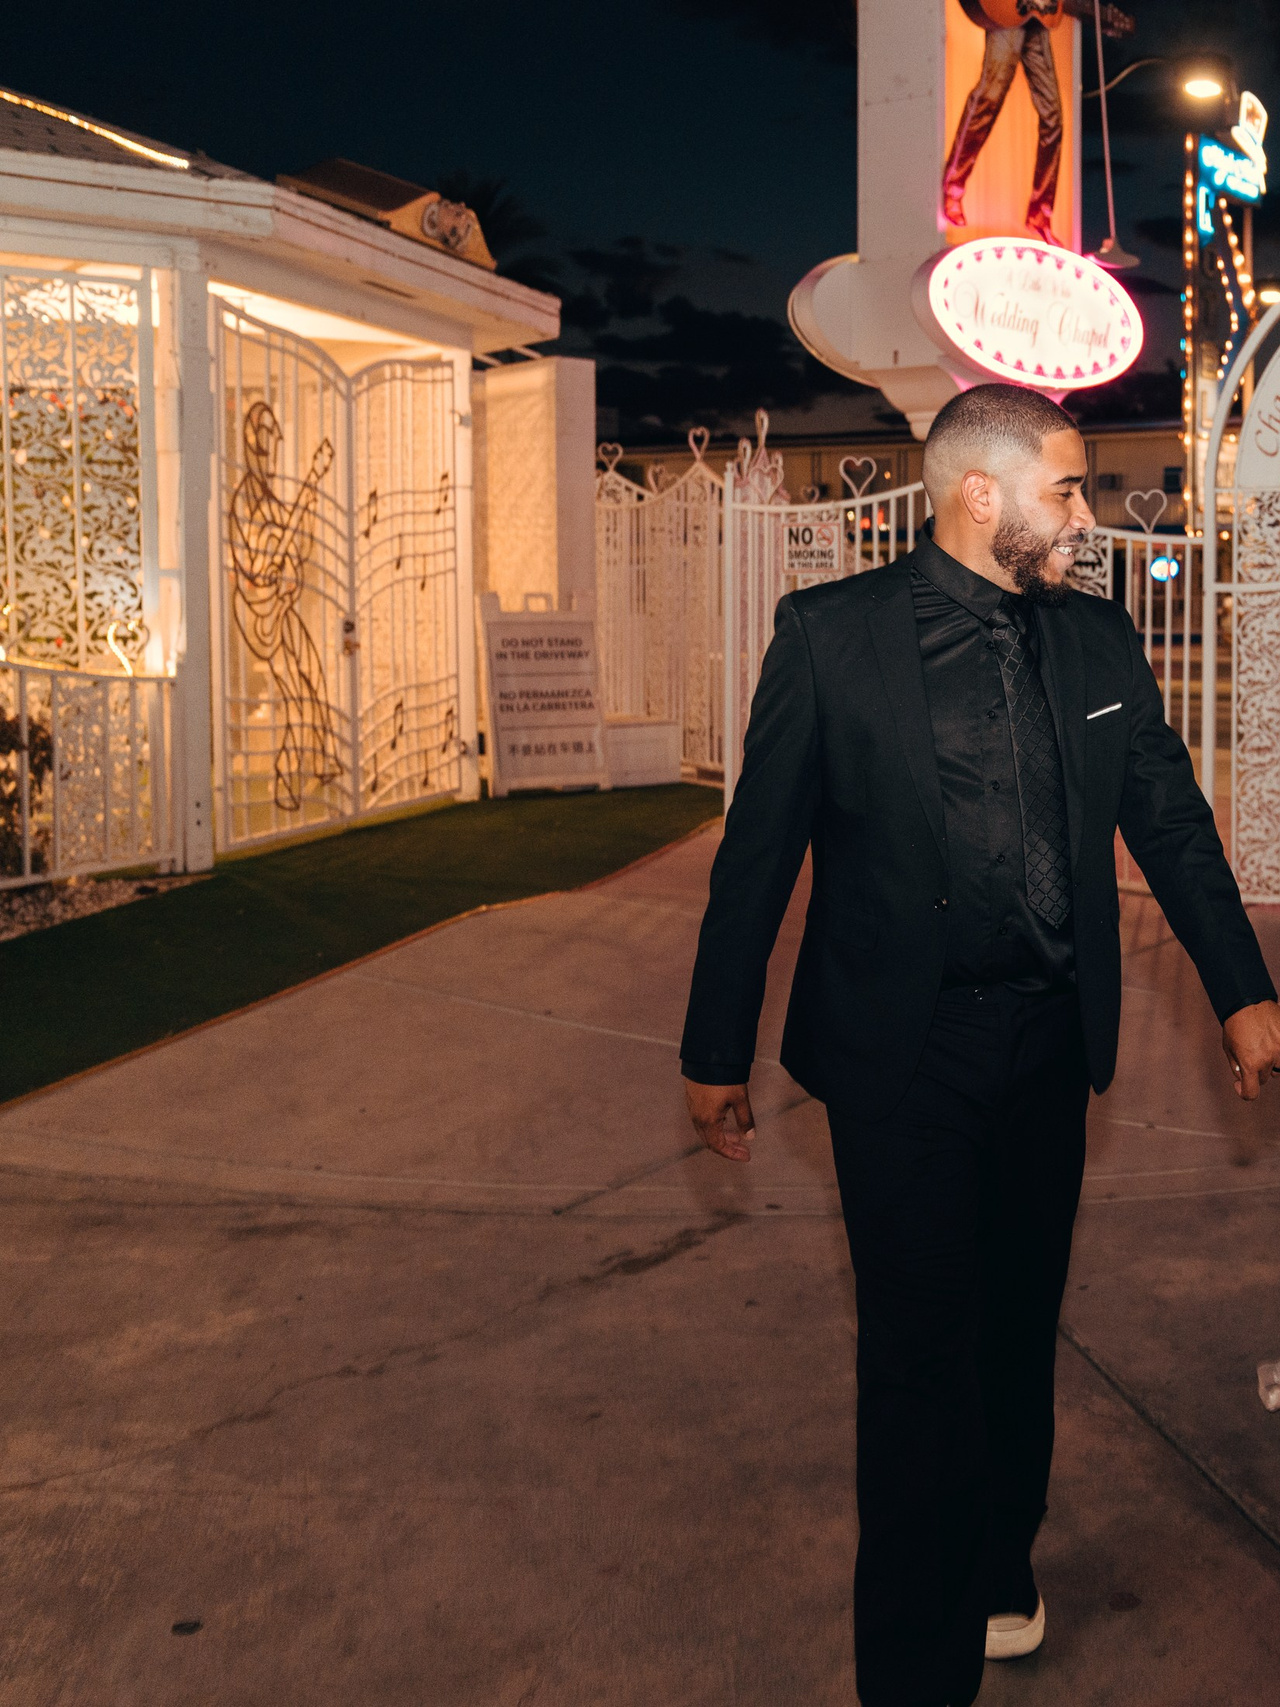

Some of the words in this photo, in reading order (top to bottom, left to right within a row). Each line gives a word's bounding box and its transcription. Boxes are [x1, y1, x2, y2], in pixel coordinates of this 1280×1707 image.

[953, 281, 1040, 348] Wedding
[1047, 301, 1112, 358] Chapel
[788, 527, 813, 545] NO
[788, 549, 835, 560] SMOKING
[501, 638, 519, 648] DO
[521, 637, 543, 648] NOT
[547, 637, 582, 648] STAND
[495, 651, 508, 660] IN
[510, 650, 530, 660] THE
[534, 650, 590, 660] DRIVEWAY
[499, 690, 516, 700] NO
[499, 703, 514, 713] EN
[516, 702, 530, 712] LA
[532, 701, 595, 712] CARRETERA
